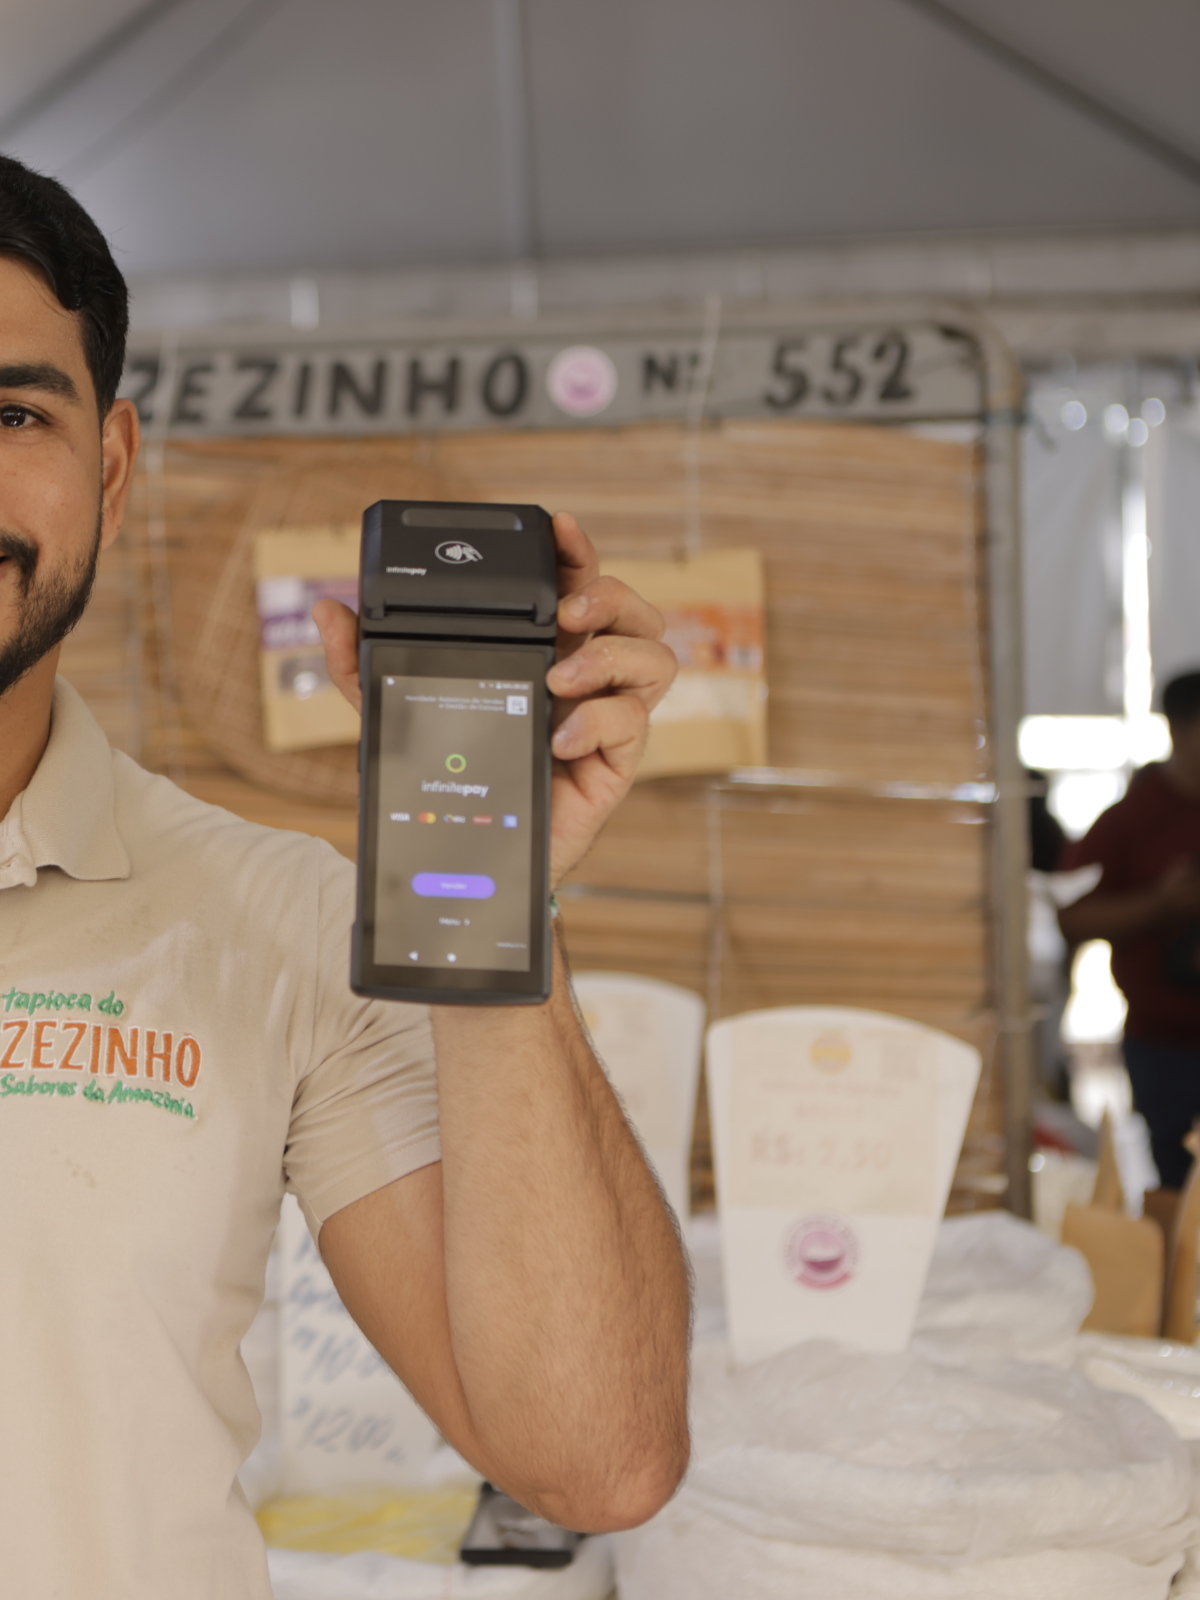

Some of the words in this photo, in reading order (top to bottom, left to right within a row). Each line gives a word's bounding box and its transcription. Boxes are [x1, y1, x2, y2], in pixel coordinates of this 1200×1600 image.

[129, 347, 530, 424] ZEZINHO
[763, 328, 917, 412] 552
[420, 779, 490, 798] infinitepay
[389, 812, 411, 822] VISA
[1, 987, 93, 1016] tapioca
[97, 990, 125, 1016] do
[0, 1020, 202, 1089] ZEZINHO
[0, 1073, 77, 1098] Sabores
[82, 1079, 106, 1102] da
[108, 1081, 196, 1119] Amazônia
